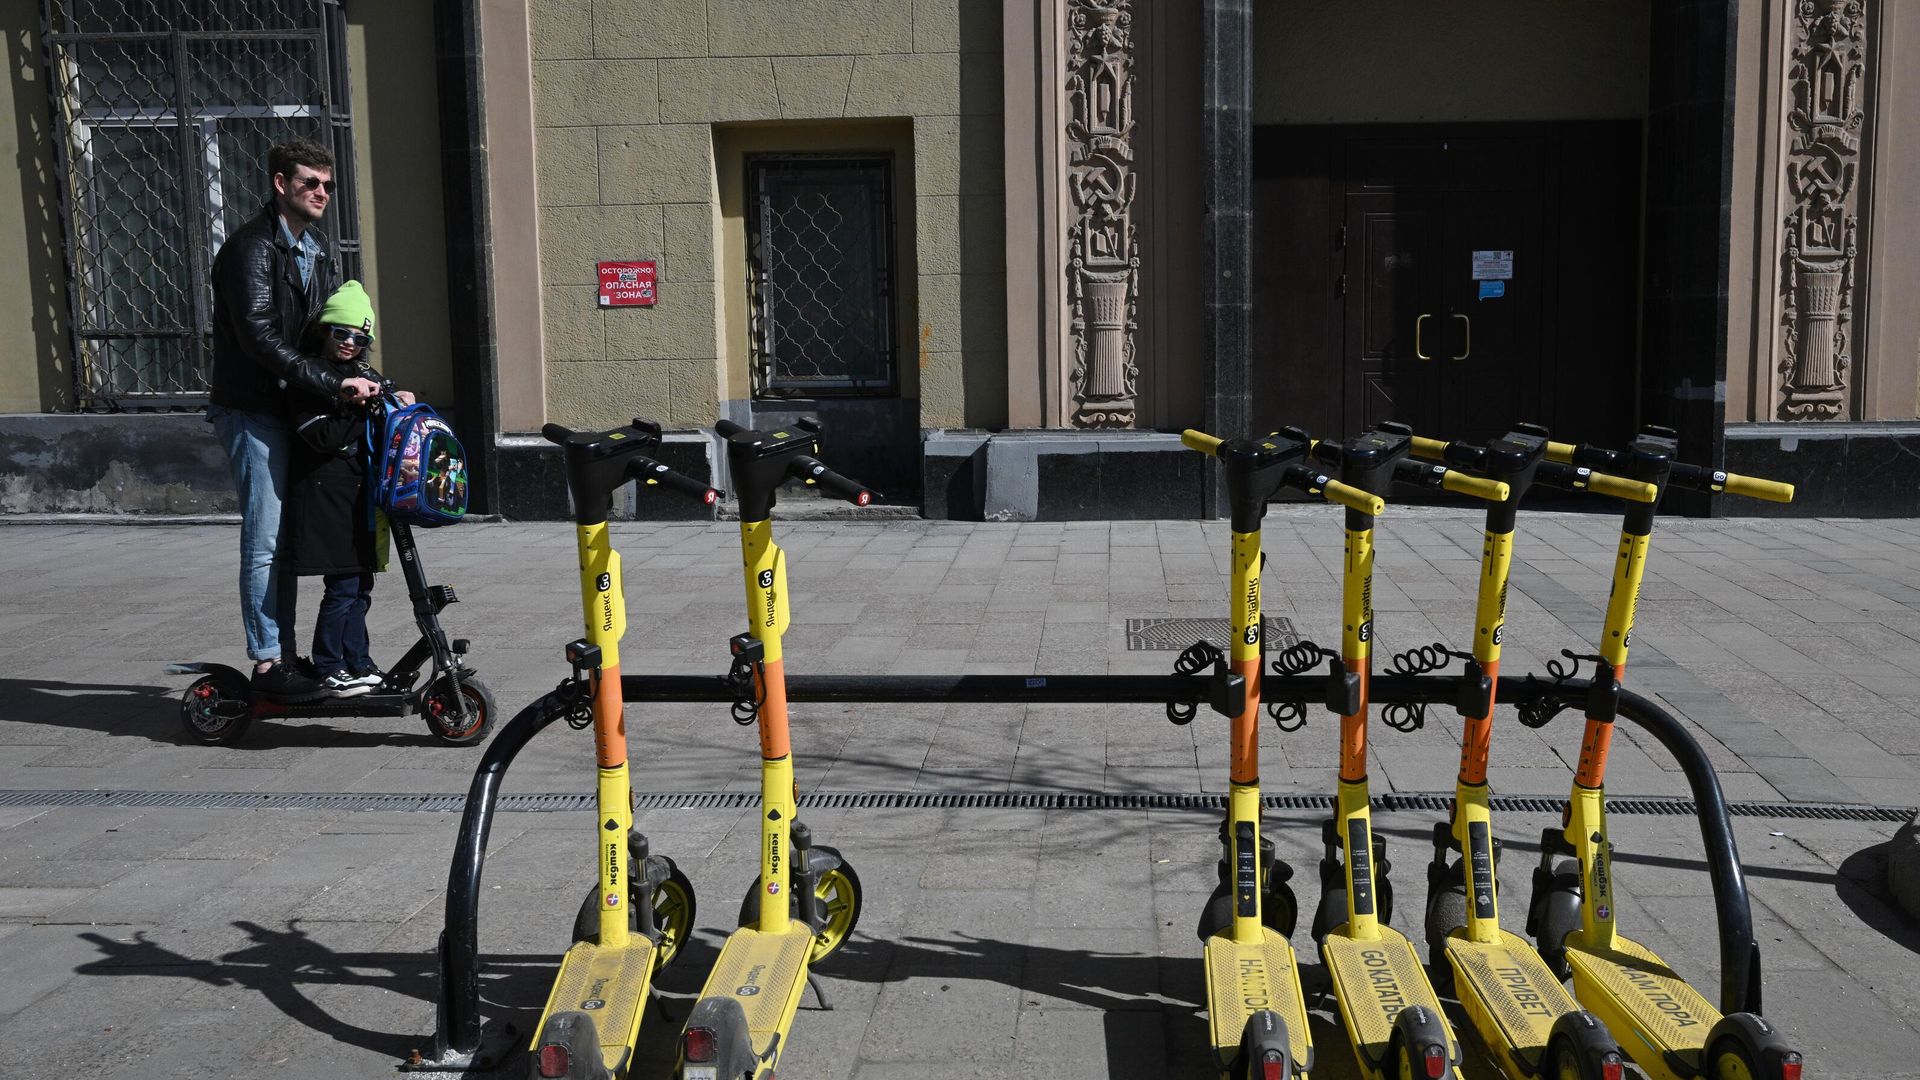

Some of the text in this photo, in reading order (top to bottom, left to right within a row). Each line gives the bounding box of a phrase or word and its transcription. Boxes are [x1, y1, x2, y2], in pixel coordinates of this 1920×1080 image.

[605, 281, 652, 289] ОПАСНАЯ
[616, 291, 642, 299] ЗОНА
[599, 573, 612, 631] Яндекс Go
[761, 570, 775, 627] Яндекс Go
[1246, 577, 1258, 643] Яндекс Go
[1361, 575, 1371, 620] Яндекс
[610, 843, 619, 885] кешбэк
[772, 833, 781, 874] кешбэк
[1597, 854, 1607, 897] кешбэк
[1361, 950, 1405, 1028] GO КАТАТЬС
[1496, 968, 1553, 1018] ПРИВЕТ
[1645, 993, 1698, 1027] ПОРА
